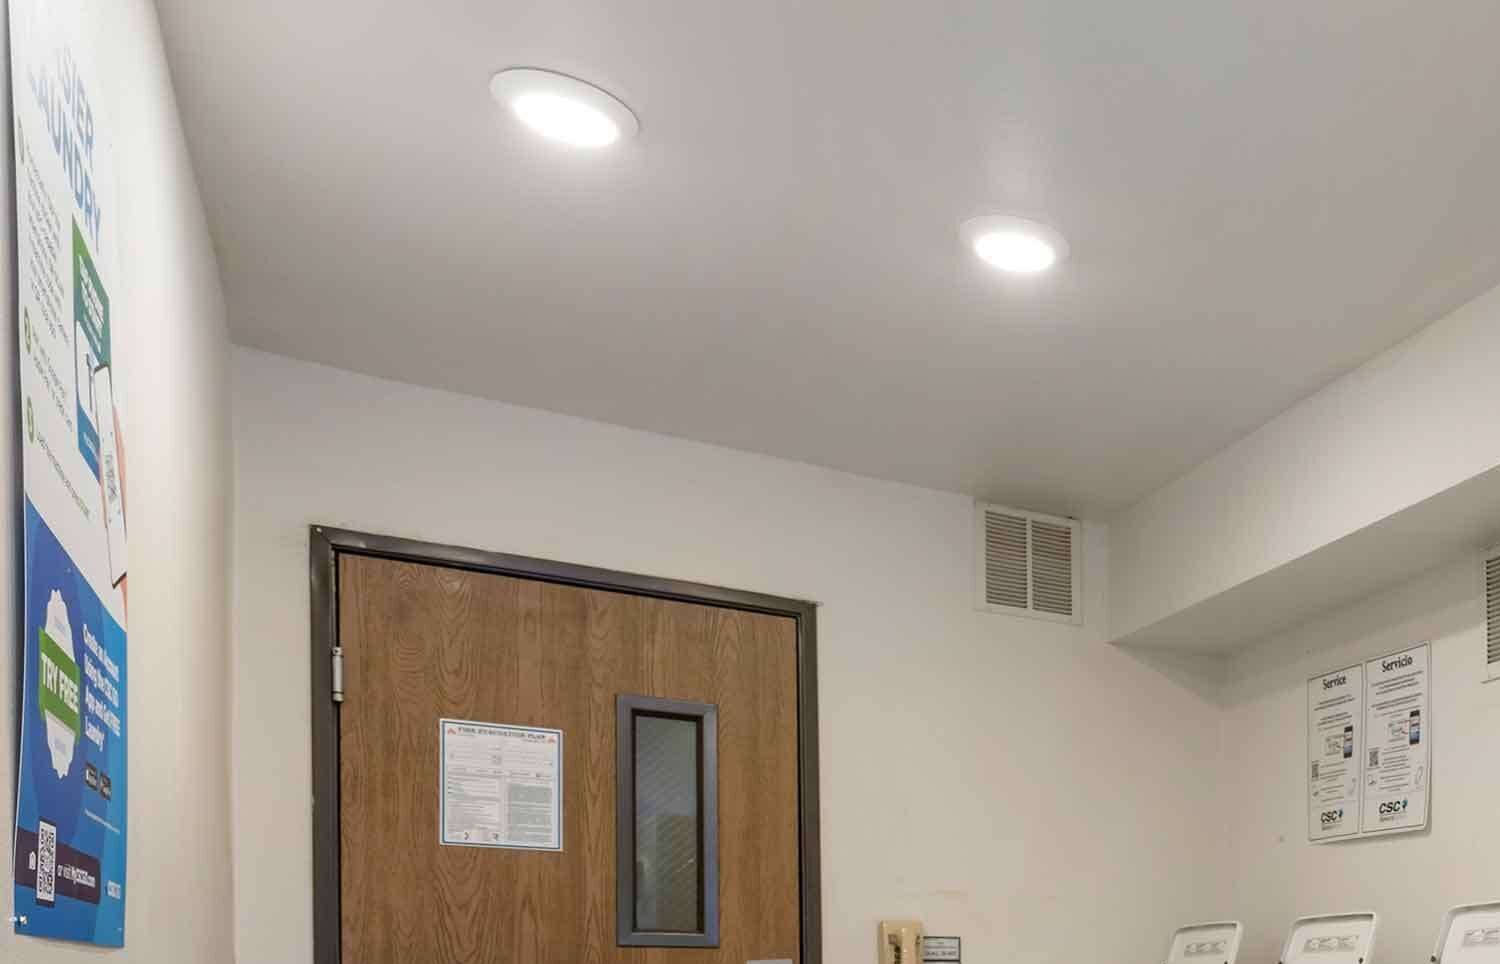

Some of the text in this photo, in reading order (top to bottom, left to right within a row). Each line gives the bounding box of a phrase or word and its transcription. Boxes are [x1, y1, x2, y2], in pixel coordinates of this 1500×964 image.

[1382, 656, 1413, 672] Servicio
[41, 652, 79, 714] TRY FREE
[1322, 674, 1347, 690] Service
[1379, 801, 1401, 814] CSC
[1320, 810, 1338, 823] CSC
